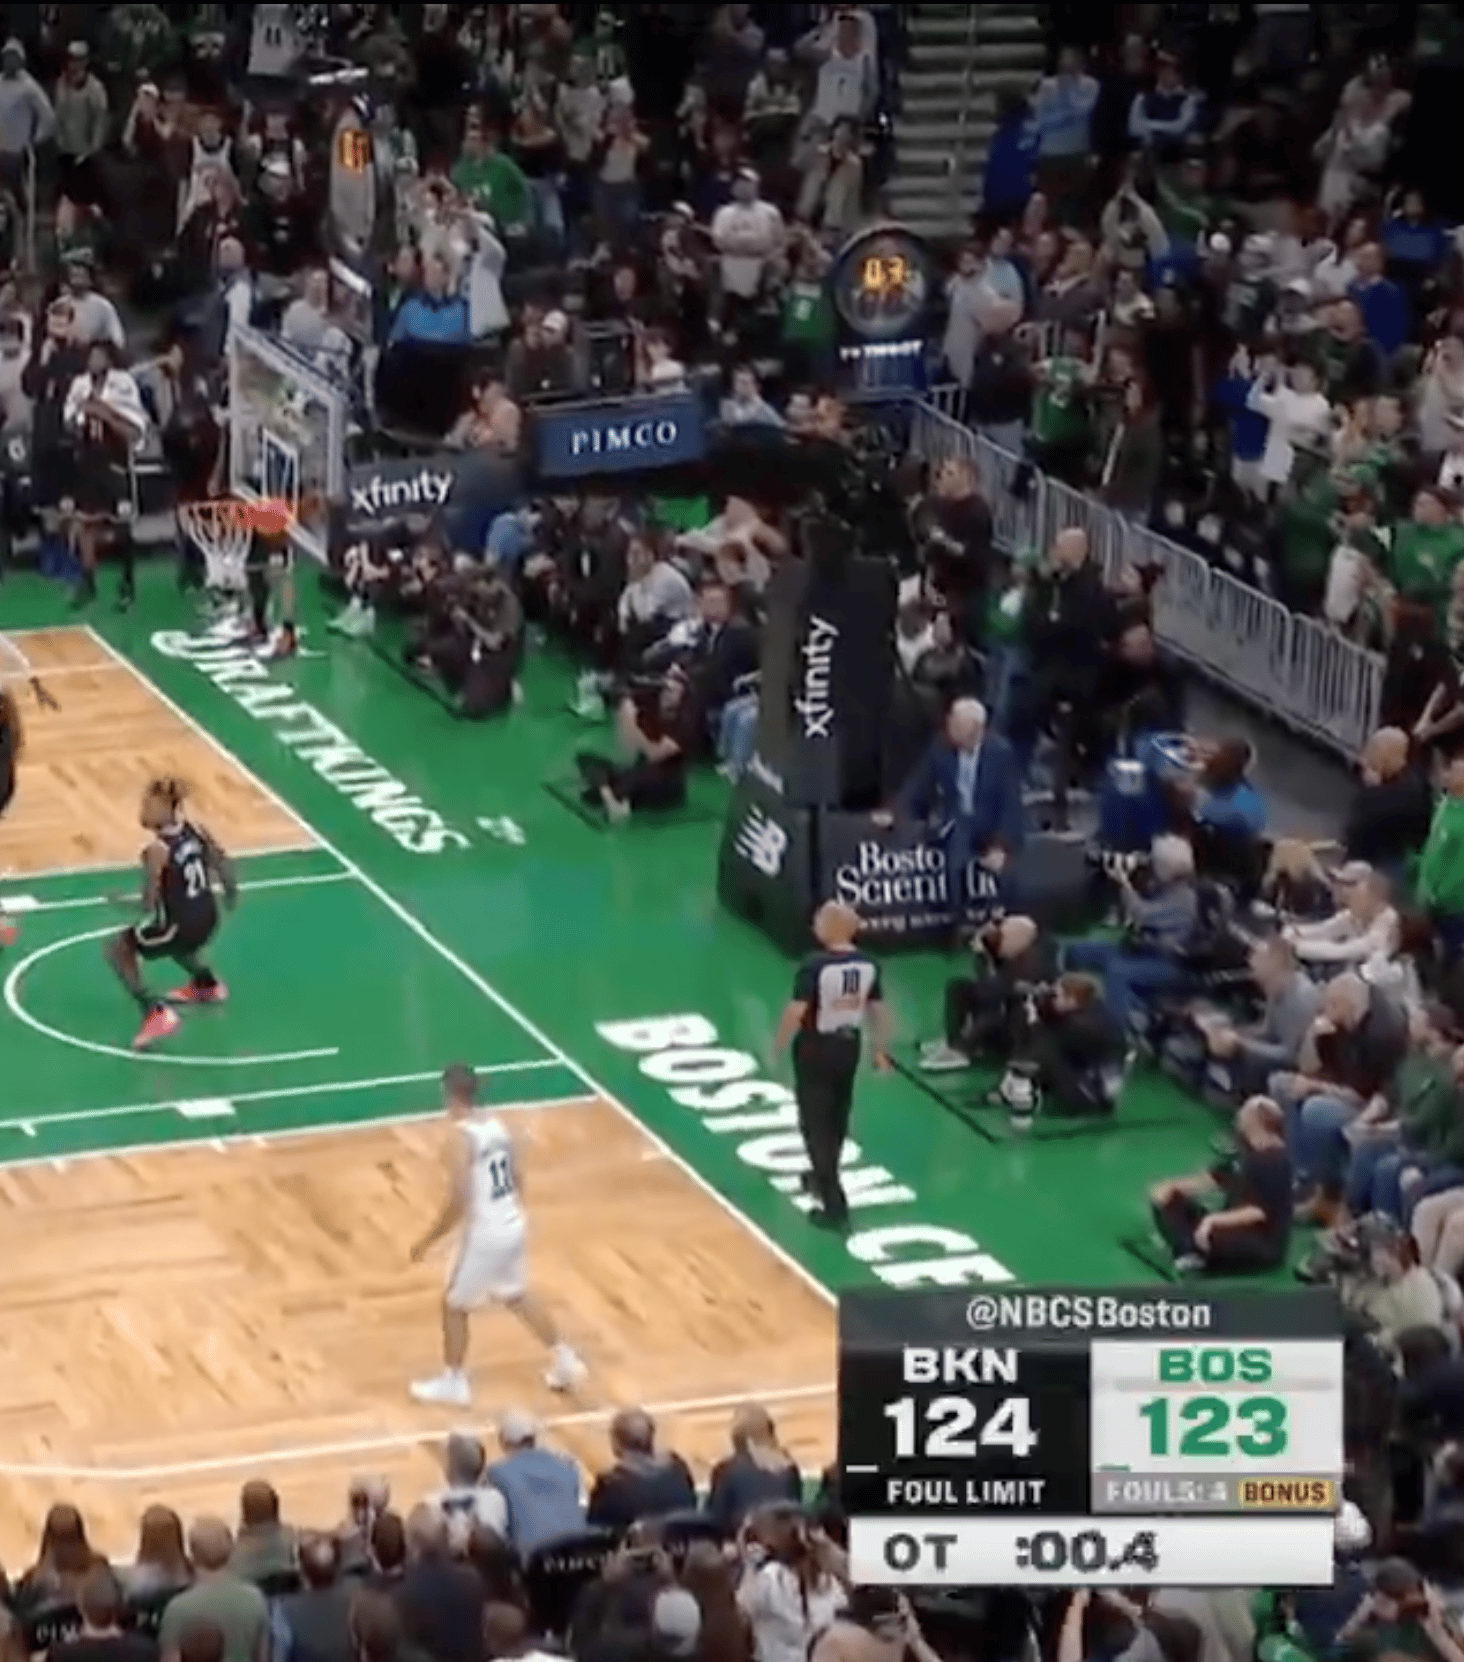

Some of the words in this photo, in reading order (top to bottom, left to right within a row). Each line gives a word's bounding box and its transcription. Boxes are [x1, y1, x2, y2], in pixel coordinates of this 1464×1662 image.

[571, 420, 678, 455] PIMCO
[351, 469, 455, 516] xfinity
[794, 614, 840, 739] xfinity
[150, 628, 474, 855] DRAFTKINGS
[858, 840, 948, 876] Bosto
[593, 1011, 918, 1213] BOSTON
